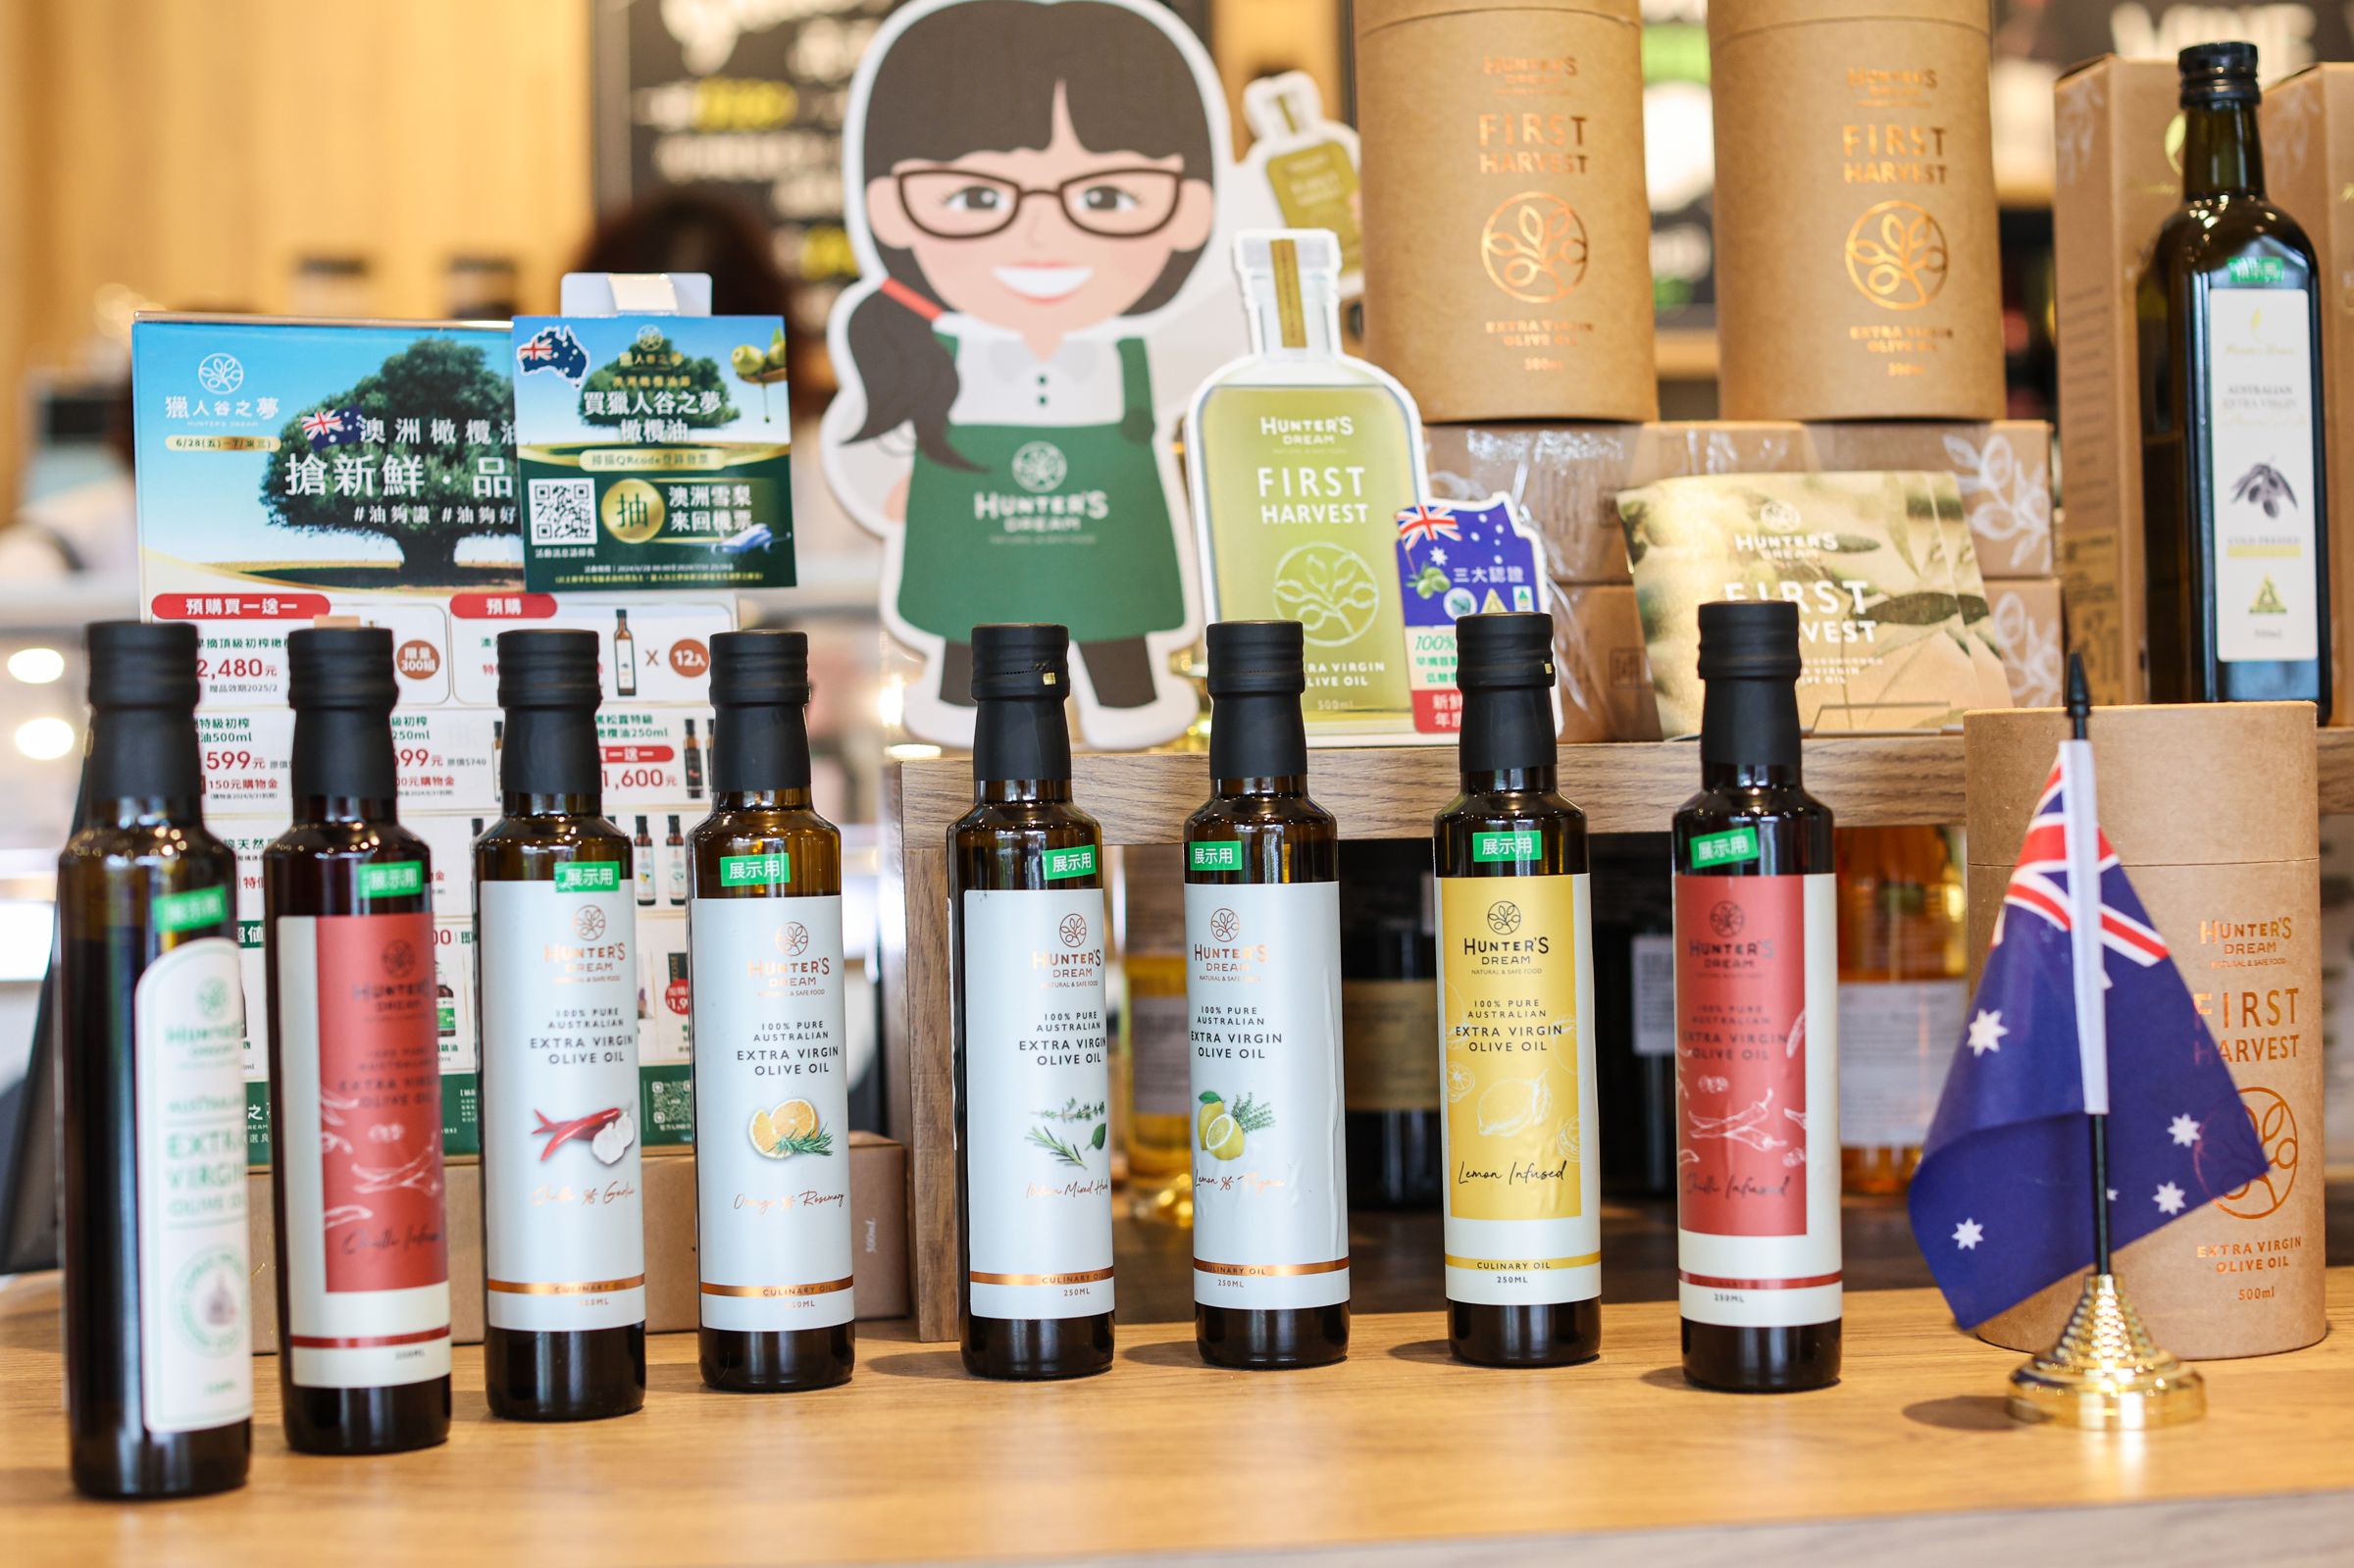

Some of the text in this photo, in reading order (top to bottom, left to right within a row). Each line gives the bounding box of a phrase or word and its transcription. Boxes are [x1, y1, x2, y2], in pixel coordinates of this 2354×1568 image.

[1479, 113, 1586, 146] FIRST
[1842, 125, 1946, 157] FIRST
[1480, 152, 1586, 174] HARVEST
[1844, 162, 1947, 183] HARVEST
[165, 396, 280, 420] 獵人谷之夢
[584, 390, 722, 416] 買獵人谷之夢
[620, 418, 689, 443] 橄欖油
[1260, 416, 1355, 435] HUNTER'S
[1257, 466, 1366, 498] FIRST
[669, 484, 752, 508] 澳洲雪梨
[973, 489, 1110, 520] HUNTER'S
[616, 492, 648, 529] 抽
[1260, 503, 1369, 525] HARVEST
[671, 510, 752, 532] 來回機票
[1735, 531, 1839, 551] HUNTER'S
[1453, 566, 1525, 583] 三大認證
[486, 597, 522, 615] 預購
[1723, 580, 1869, 615] FIRST
[185, 598, 298, 615] 預購買一送一
[1801, 620, 1877, 643] VEST
[1332, 661, 1385, 673] VIRGIN
[1306, 675, 1369, 686] LIVE OIL
[196, 718, 250, 729] 特級初榨
[1482, 837, 1532, 856] 展示用
[1697, 835, 1750, 861] 展示用
[1051, 851, 1093, 874] 展示用
[1194, 846, 1233, 866] 展示用
[565, 867, 614, 885] 展示用
[728, 860, 782, 880] 展示用
[2199, 916, 2292, 944] HUNTER'S
[543, 941, 627, 963] HUNTER'S
[1194, 942, 1270, 963] HUNTER'S
[1463, 936, 1550, 956] HUNTER'S
[1689, 938, 1775, 959] HUNTER'S
[2224, 942, 2277, 955] DREAM
[1032, 947, 1102, 971] HUNTER'S
[1205, 962, 1252, 972] DREAM
[1481, 956, 1531, 965] DREAM
[746, 956, 831, 980] HUNTER'S
[1052, 967, 1094, 979] DREAM
[767, 976, 818, 988] DREAM
[592, 1007, 620, 1017] PURE
[1201, 1006, 1257, 1015] 100% PURE
[1474, 999, 1501, 1008] 100%
[2193, 987, 2299, 1030] FIRST
[1045, 1011, 1098, 1022] 100% PURE
[1197, 1016, 1265, 1026] AUSTRALIAN
[1467, 1009, 1547, 1019] AUSTRALIAN
[547, 1018, 625, 1030] AUSTRALIAN
[761, 1020, 825, 1031] 100% PURE
[1036, 1021, 1100, 1033] AUSTRALIAN
[1456, 1025, 1562, 1037] EXTRA VIRGIN
[529, 1034, 634, 1049] EXTRA VIRGIN
[753, 1031, 830, 1042] AUSTRALIAN
[1019, 1036, 1106, 1051] EXTRA VIRGIN
[1191, 1031, 1283, 1044] EXTRA VIRGIN
[1729, 1032, 1788, 1044] VIRGIN
[737, 1045, 840, 1061] EXTRA VIRGIN
[1198, 1046, 1265, 1059] OLIVE OIL
[1468, 1040, 1548, 1052] OLIVE OIL
[1692, 1047, 1769, 1060] OLIVE OIL
[2194, 1034, 2300, 1063] ARVEST
[548, 1051, 625, 1065] OLIVE OIL
[1037, 1052, 1101, 1066] OLIVE OIL
[754, 1062, 830, 1077] OLIVE OIL
[1195, 1169, 1218, 1189] Lemon
[1458, 1160, 1567, 1186] Lemon Infused
[1064, 1180, 1094, 1198] Mixed
[797, 1189, 845, 1209] Rosemary
[2197, 1236, 2302, 1258] EXTRA VIRGIN
[1476, 1261, 1528, 1270] CULINARY
[2217, 1256, 2289, 1273] OLIVE OIL
[1042, 1275, 1091, 1285] CULINARY
[1217, 1279, 1245, 1288] 250ML
[762, 1287, 816, 1296] CULINARY
[1063, 1288, 1091, 1296] 250ML
[2238, 1286, 2276, 1301] 500ml
